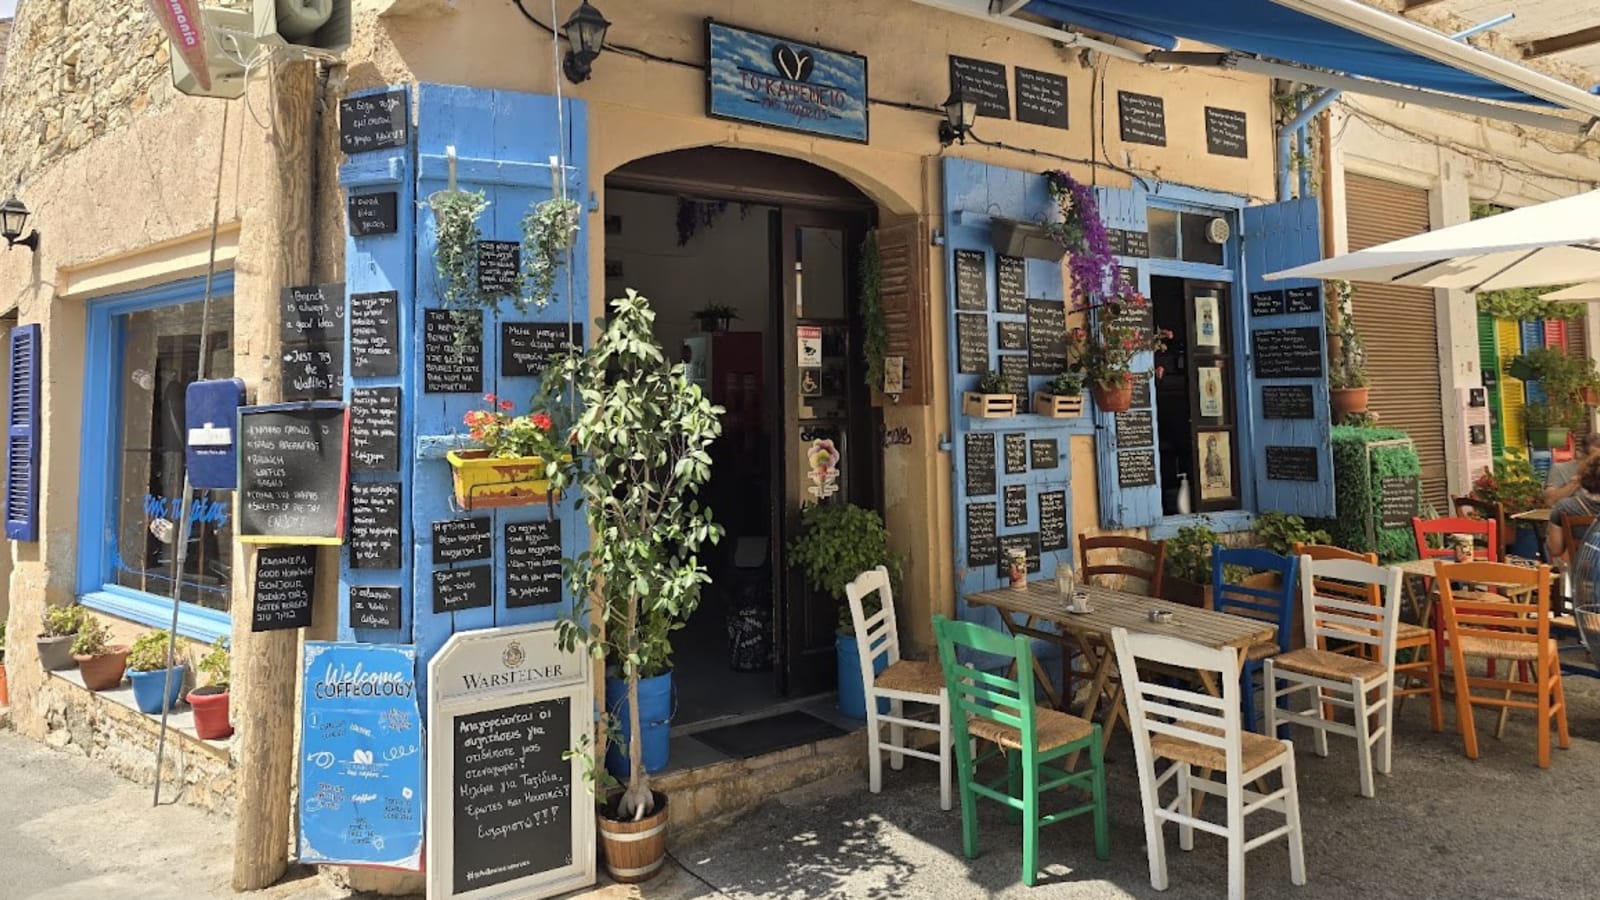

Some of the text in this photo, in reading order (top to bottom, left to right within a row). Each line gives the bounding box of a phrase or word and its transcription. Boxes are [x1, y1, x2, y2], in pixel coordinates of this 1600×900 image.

[287, 302, 330, 316] is always
[296, 317, 313, 333] good
[258, 569, 280, 578] GOOD
[258, 580, 304, 590] BONJOUR
[325, 661, 405, 684] Welcome
[462, 664, 563, 690] WARSTEINER
[315, 681, 414, 699] COFFEOLOGY
[539, 709, 551, 719] οι
[527, 725, 546, 741] για
[521, 743, 541, 756] μας
[501, 780, 518, 793] για
[507, 797, 522, 807] και
